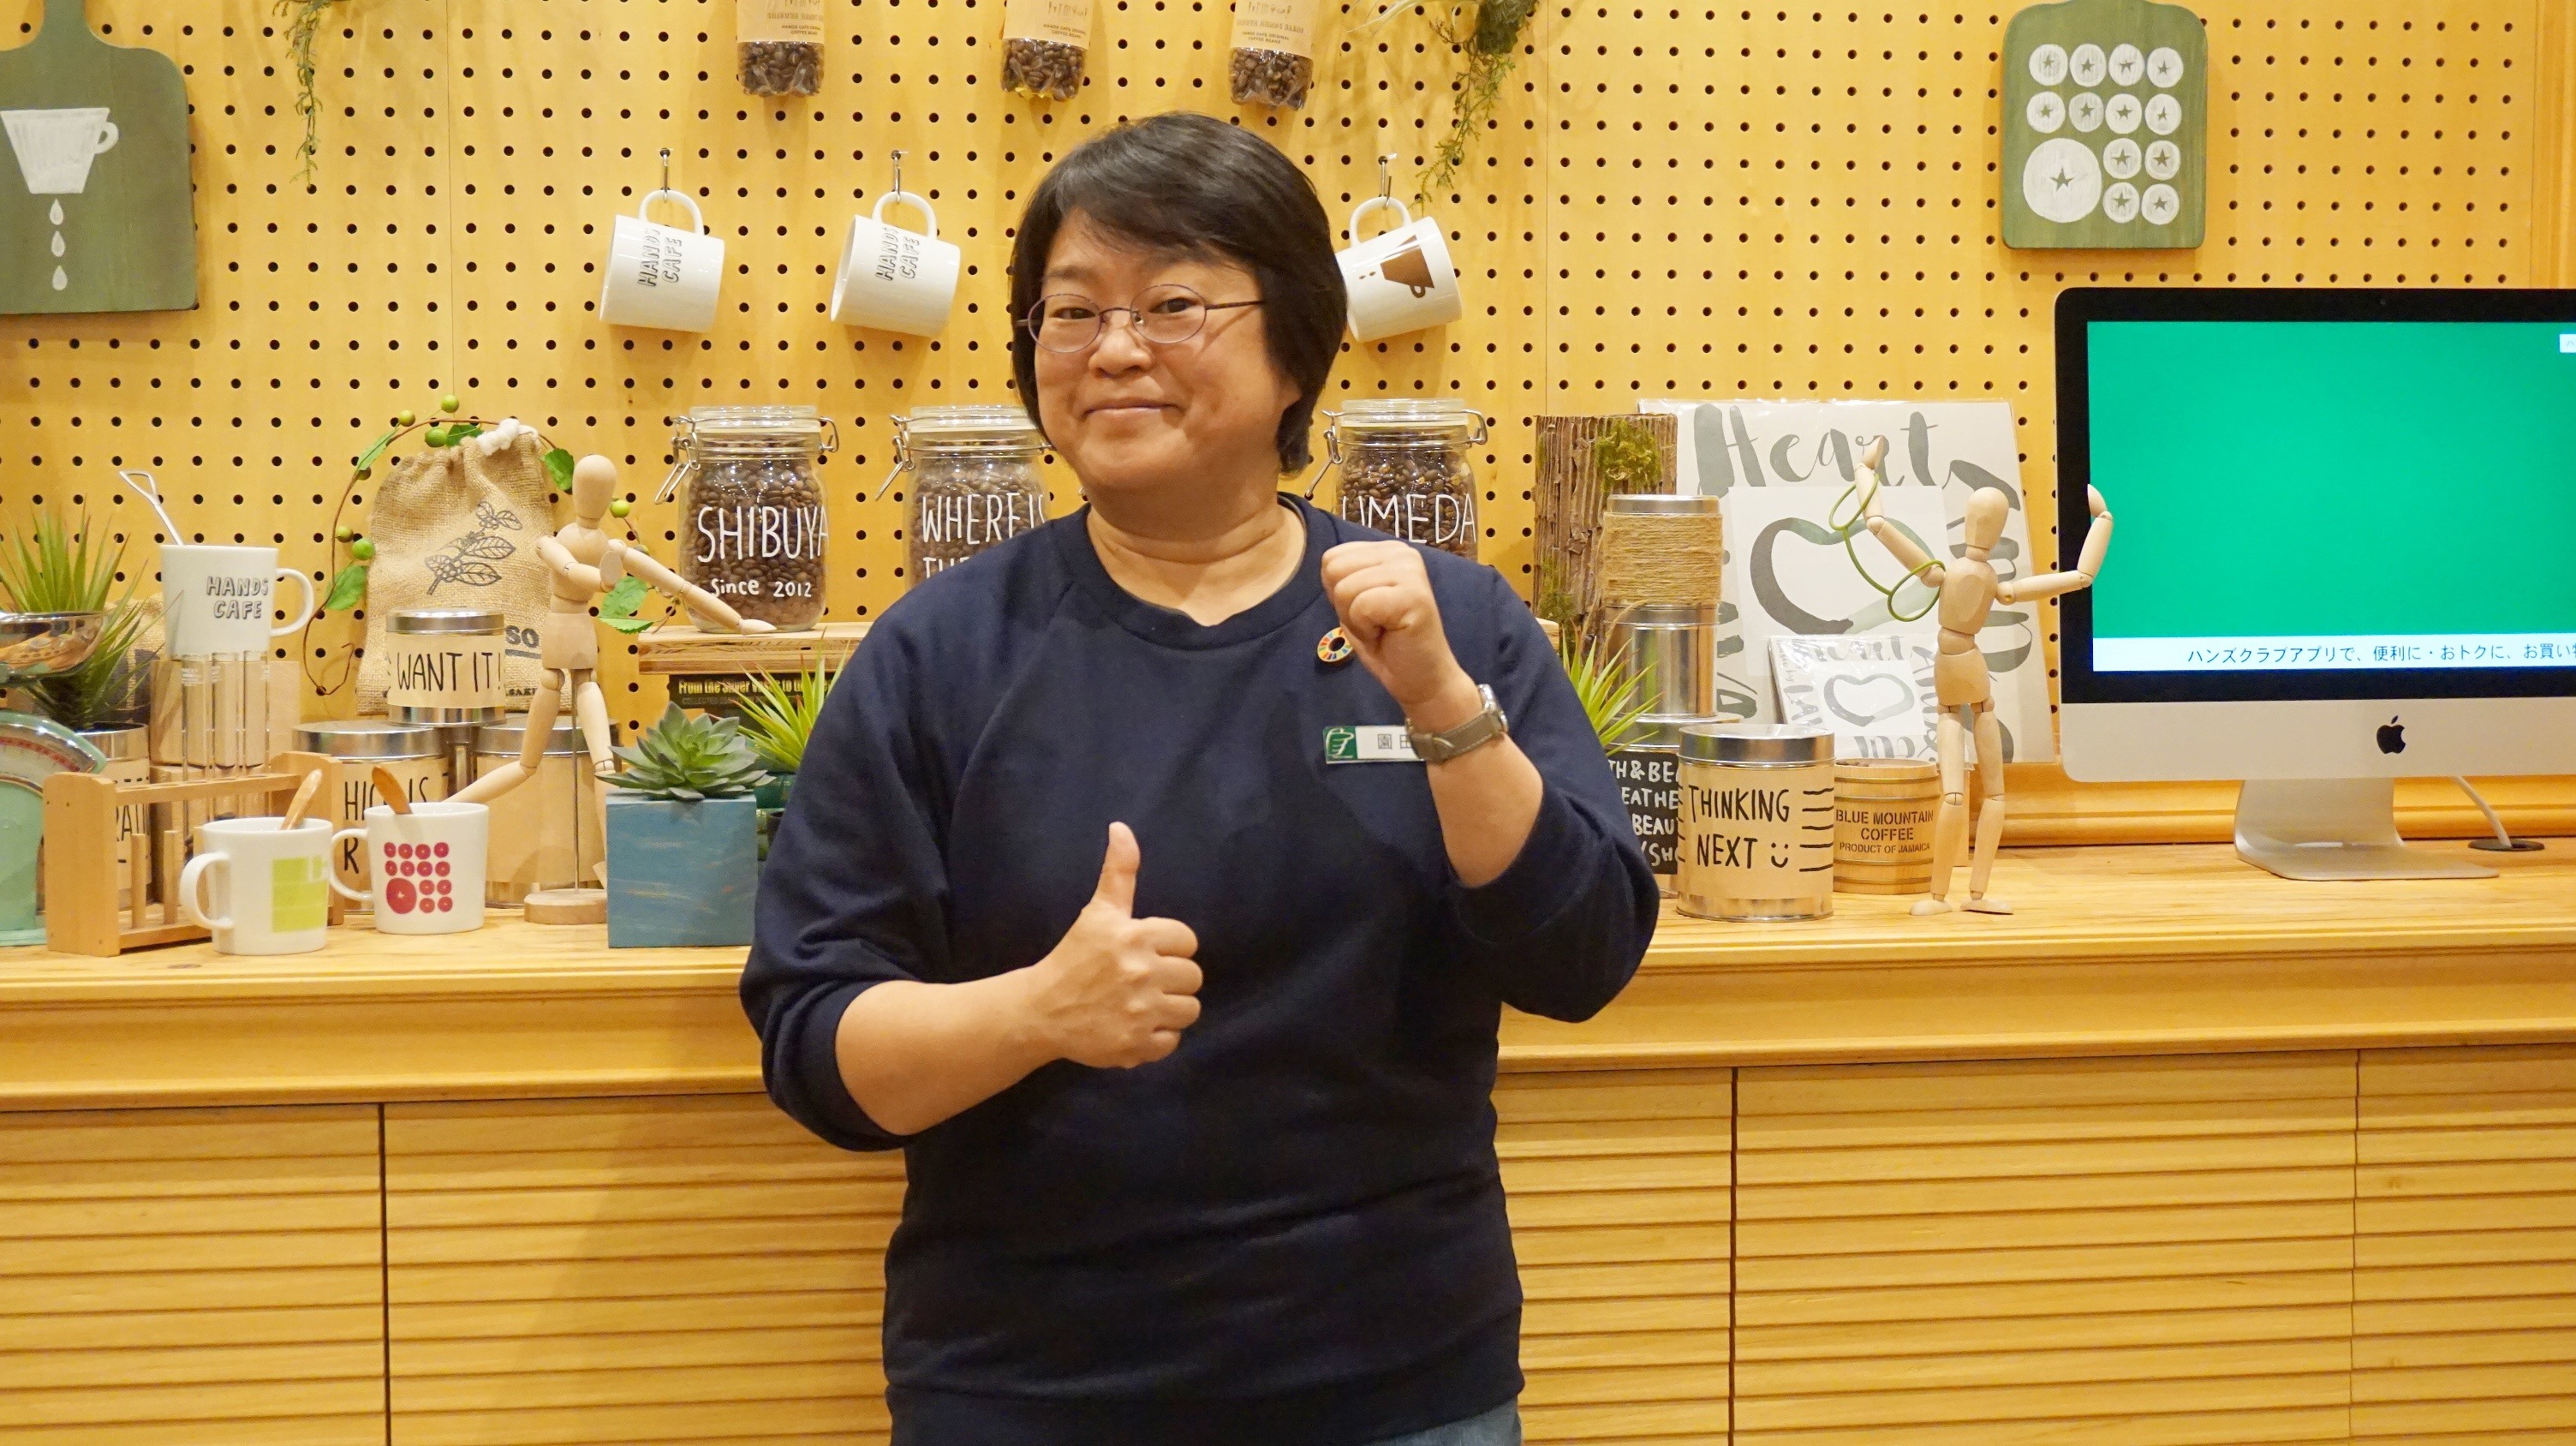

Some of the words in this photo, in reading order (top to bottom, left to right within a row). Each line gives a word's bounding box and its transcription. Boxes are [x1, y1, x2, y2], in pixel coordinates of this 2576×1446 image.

[637, 228, 660, 287] HANDS
[661, 236, 683, 284] CAFE
[875, 226, 898, 282] HANDS
[898, 236, 920, 279] CAFE
[698, 505, 830, 563] SHIBUYA
[206, 576, 269, 596] HANDS
[711, 578, 760, 598] Since
[773, 581, 812, 597] 2012
[213, 600, 262, 619] CAFE
[397, 652, 463, 692] WANT
[473, 651, 502, 693] IT!
[678, 679, 703, 694] From
[1689, 785, 1789, 822] THINKING
[1835, 810, 1869, 824] BLUE
[1873, 810, 1934, 825] MOUNTAIN
[1696, 834, 1758, 869] NEXT
[1840, 841, 1881, 854] PRODUCT
[1884, 845, 1897, 854] OF
[1898, 841, 1930, 853] JAMAICA
[1860, 828, 1914, 841] COFFEE
